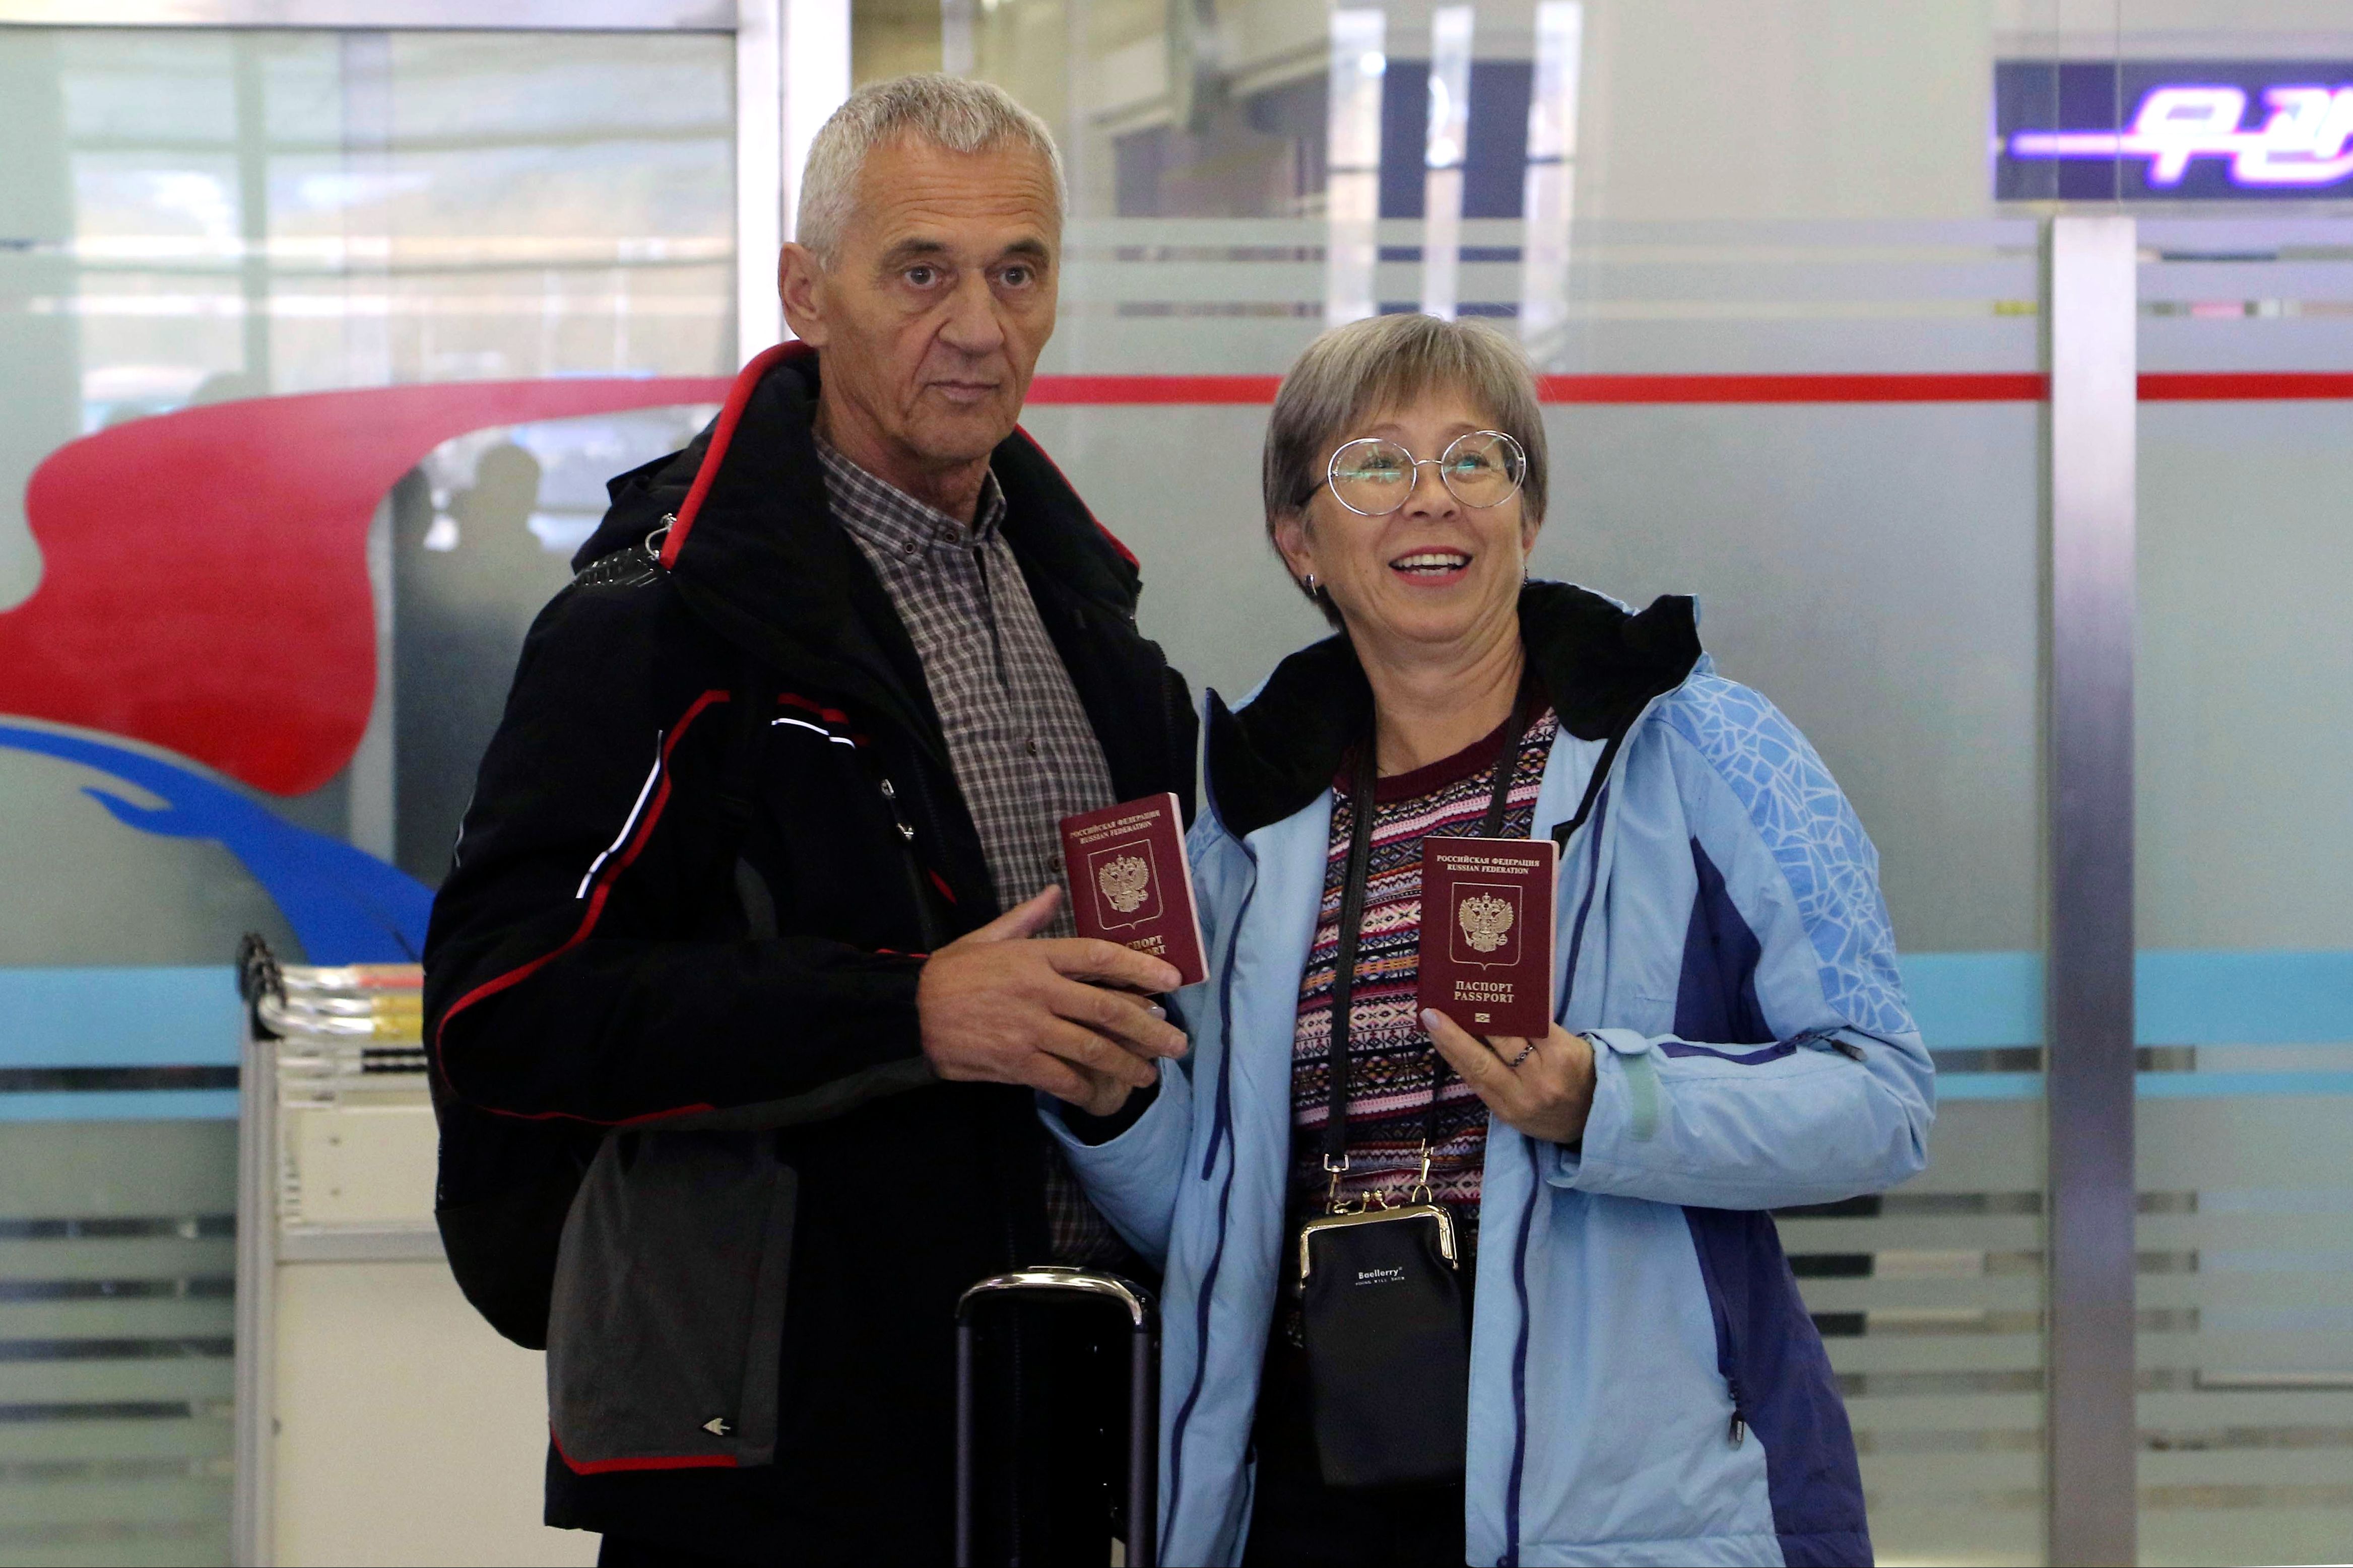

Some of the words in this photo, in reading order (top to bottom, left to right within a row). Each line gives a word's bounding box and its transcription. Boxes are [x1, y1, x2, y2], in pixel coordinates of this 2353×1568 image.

[1080, 832, 1109, 844] RUSSIAN
[1110, 821, 1152, 836] FEDERATION
[1437, 855, 1489, 864] РОССИЙСКАЯ
[1491, 858, 1540, 867] ФЕДЕРАЦИЯ
[1447, 864, 1480, 872] RUSSIAN
[1481, 865, 1530, 874] FEDERATION
[1456, 981, 1513, 992] ПАСПОРТ
[1454, 991, 1515, 1003] PASSPORT
